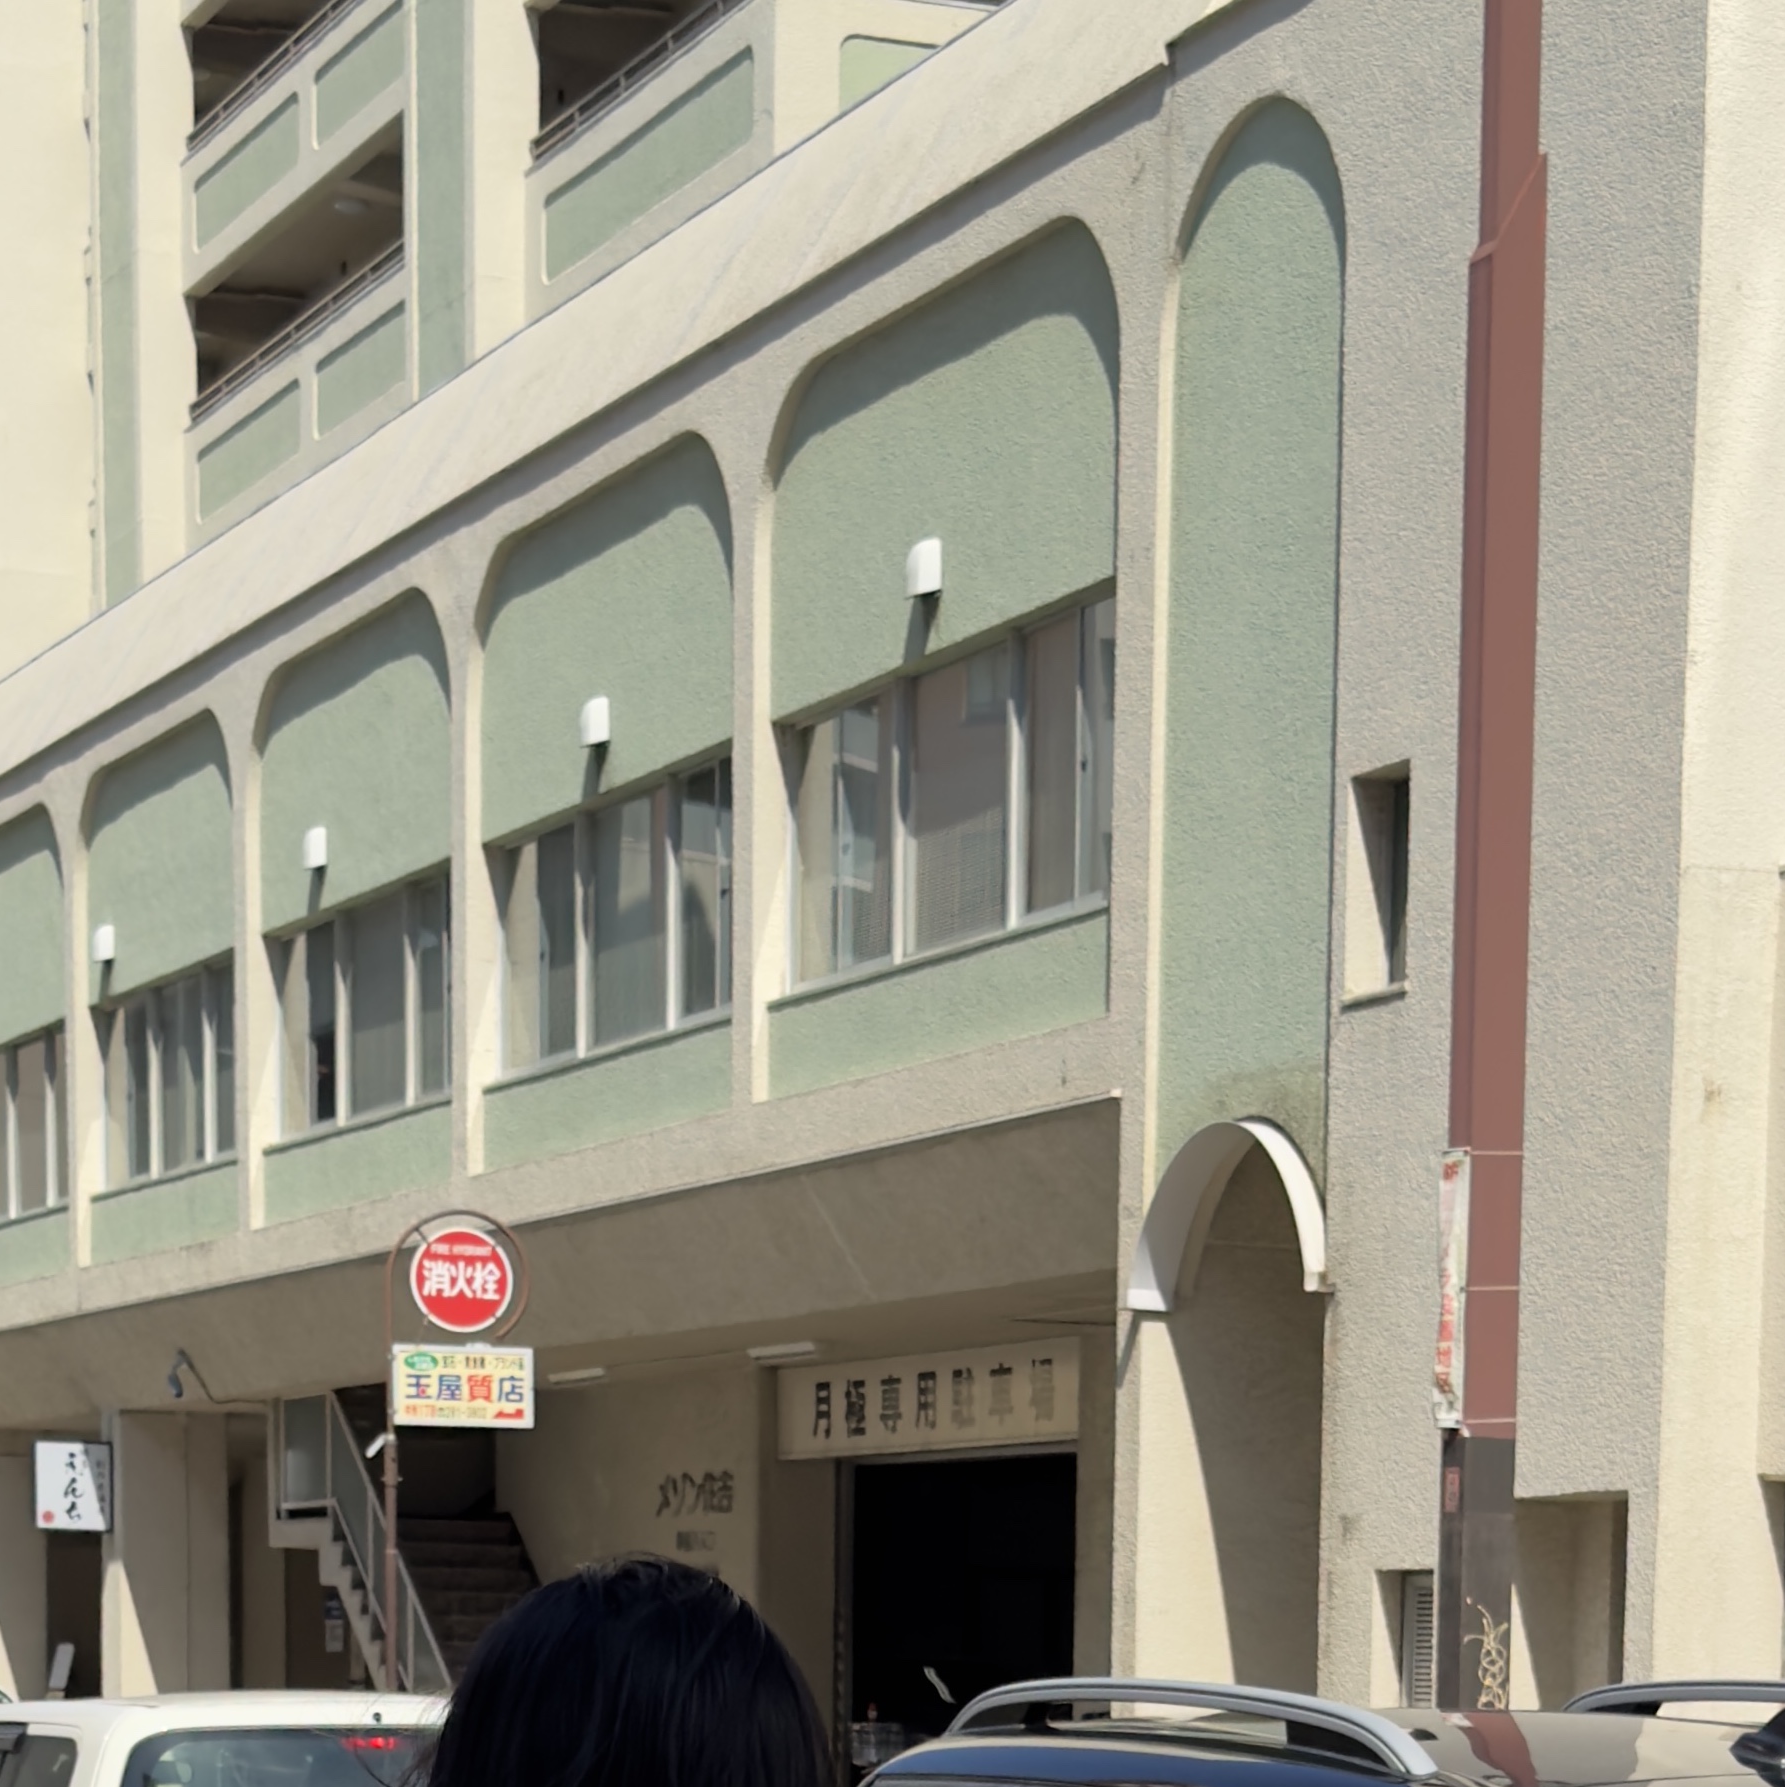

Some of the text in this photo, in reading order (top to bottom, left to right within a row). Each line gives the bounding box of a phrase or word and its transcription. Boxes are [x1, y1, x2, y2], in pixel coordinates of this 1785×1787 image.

[422, 1258, 501, 1301] 消火栓
[404, 1374, 525, 1404] 玉屋質店
[813, 1358, 1054, 1440] 月極専用駐車場
